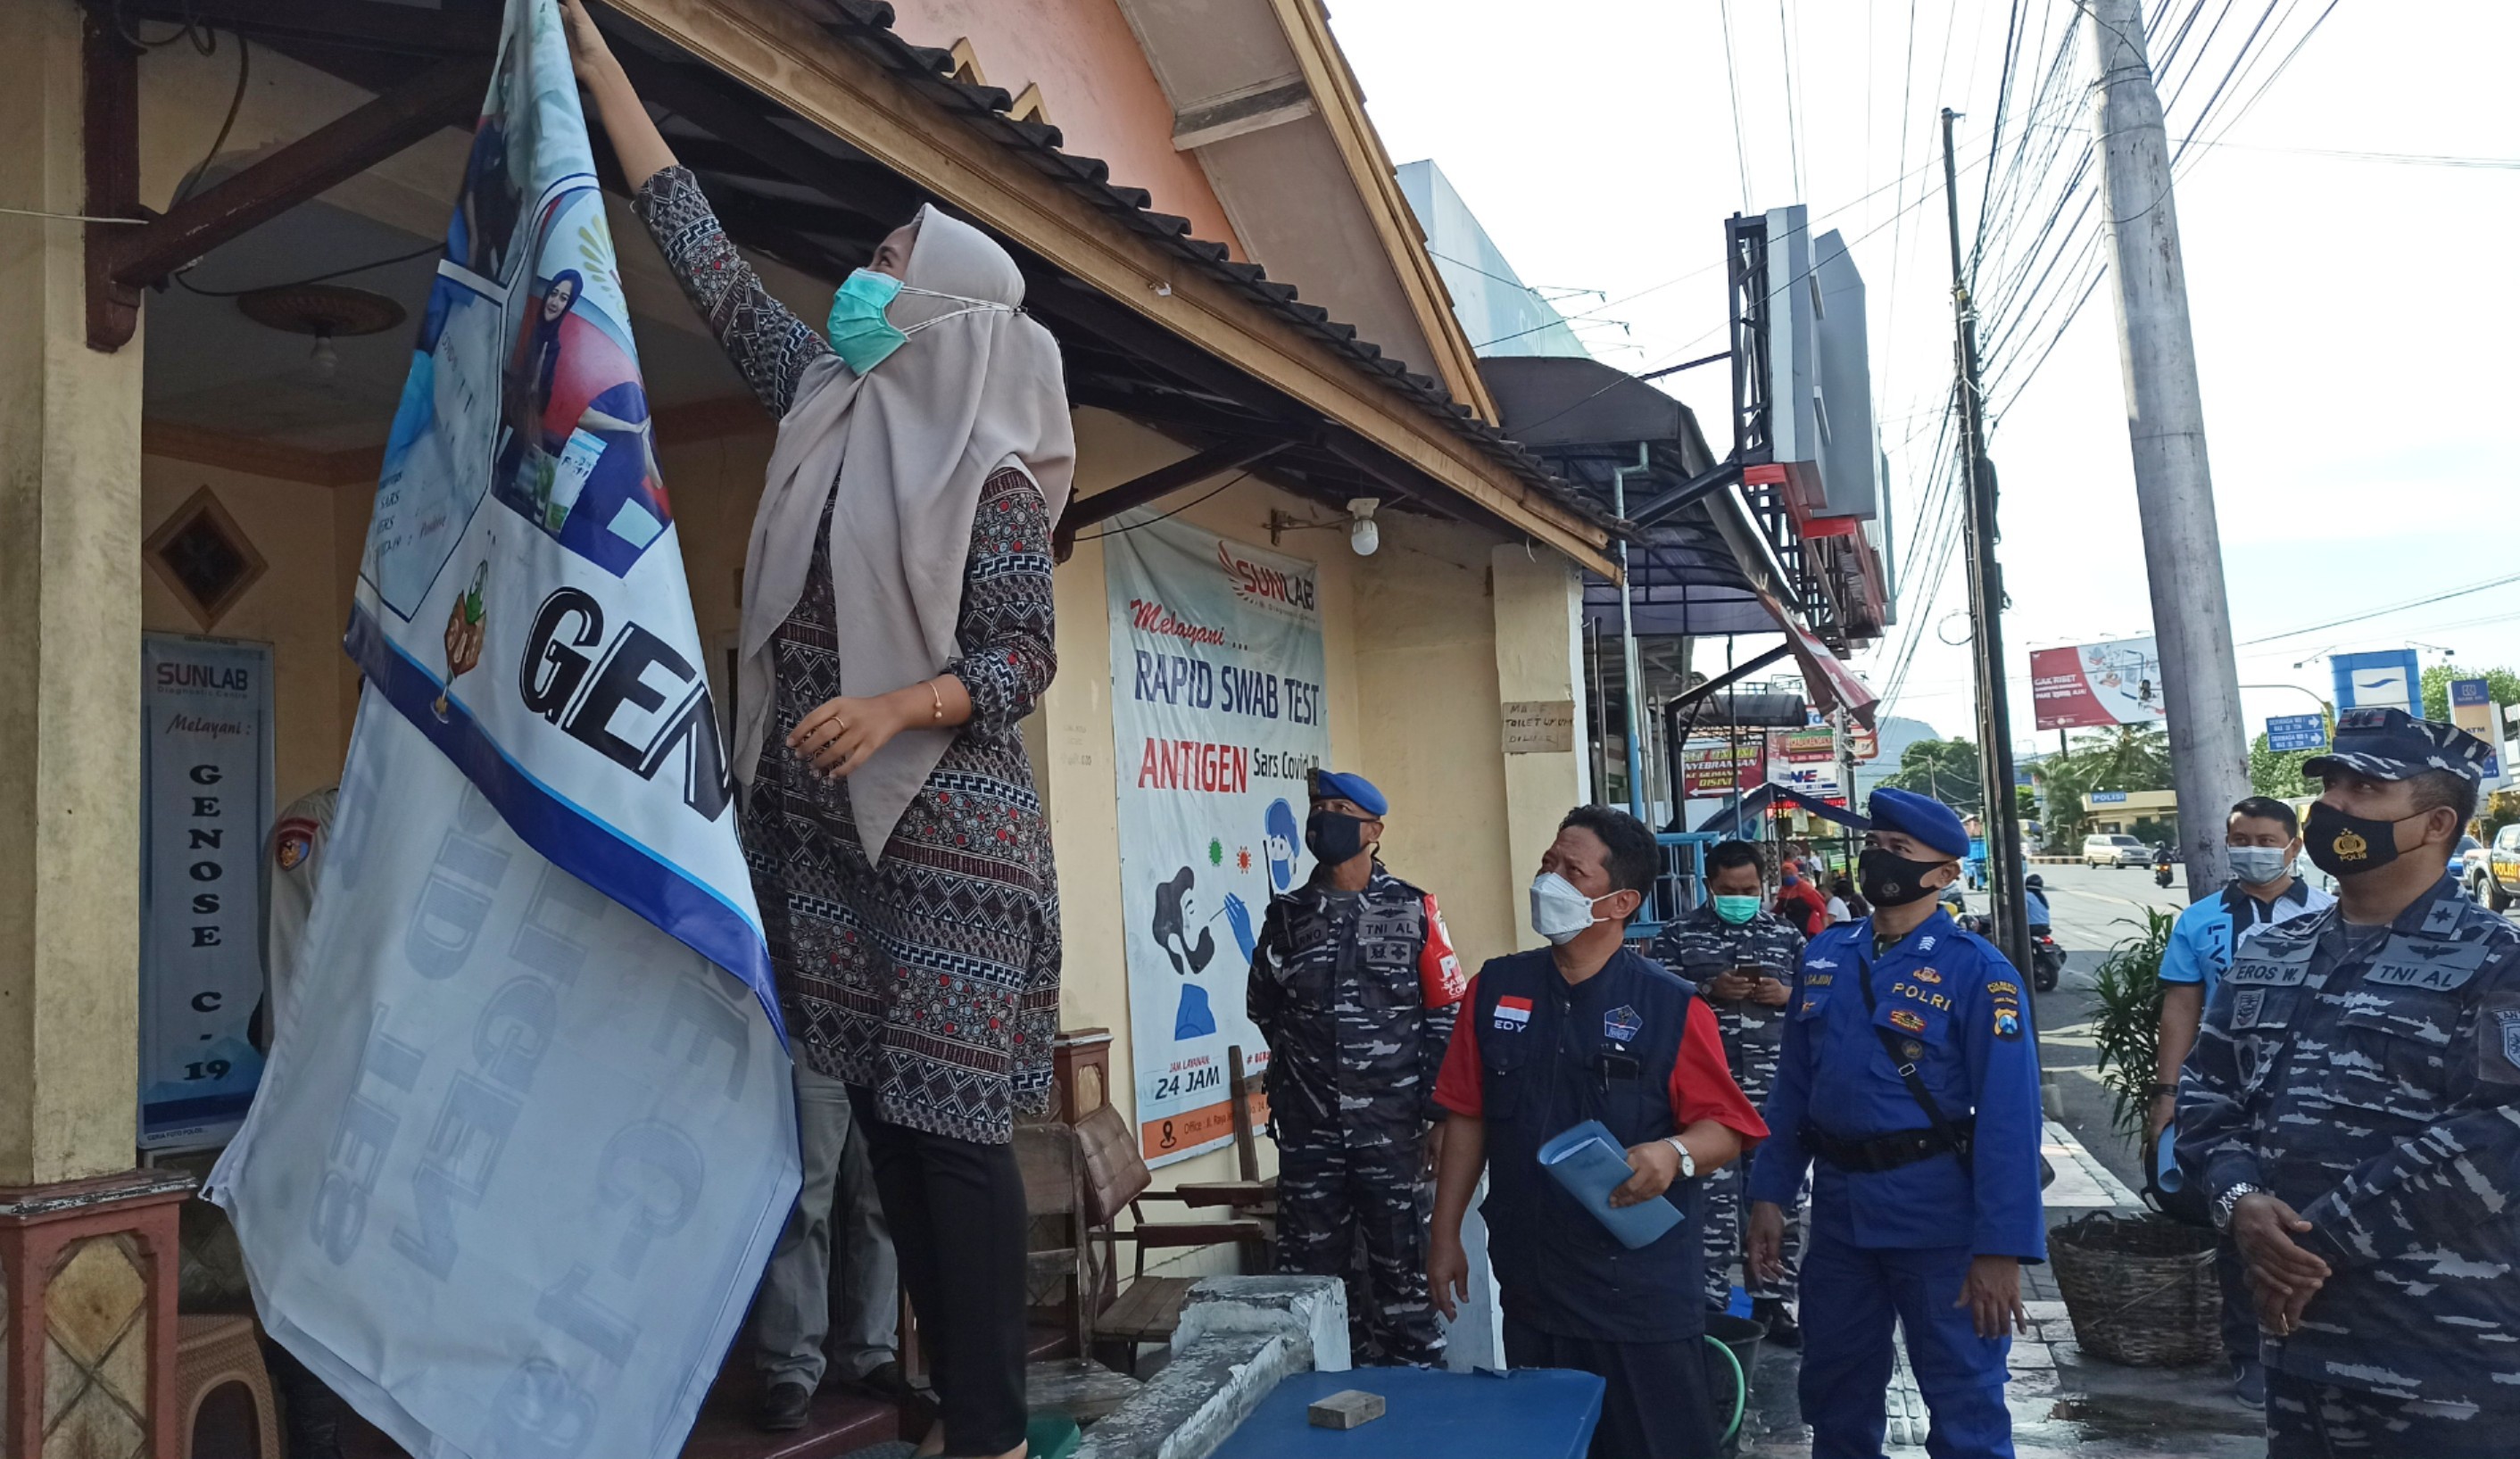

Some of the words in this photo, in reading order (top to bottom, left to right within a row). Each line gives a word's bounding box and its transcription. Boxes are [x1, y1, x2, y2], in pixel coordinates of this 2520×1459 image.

[1236, 559, 1314, 611] SUNLAB
[1130, 599, 1225, 647] Melayani
[156, 661, 248, 691] SUNLAB
[1134, 649, 1214, 710] RAPID
[1221, 665, 1279, 719] SWAB
[1283, 677, 1320, 726] TEST
[1505, 717, 1542, 727] TOILET
[1138, 737, 1248, 793] ANTIGEN
[1253, 747, 1279, 779] Sars
[2093, 793, 2126, 801] POLISI
[189, 764, 223, 948] GENOSE
[2493, 862, 2517, 876] POLISI
[1365, 924, 1388, 935] TNI
[1396, 924, 1413, 934] AL
[2235, 965, 2279, 981] EROS
[2282, 966, 2297, 981] W.
[2380, 965, 2419, 982] TNI
[2421, 969, 2454, 989] AL
[1891, 982, 1952, 1012] POLRI
[1494, 1020, 1528, 1032] EDY
[1155, 1074, 1180, 1100] 24
[1185, 1065, 1221, 1092] JAM
[1184, 1120, 1202, 1134] Office
